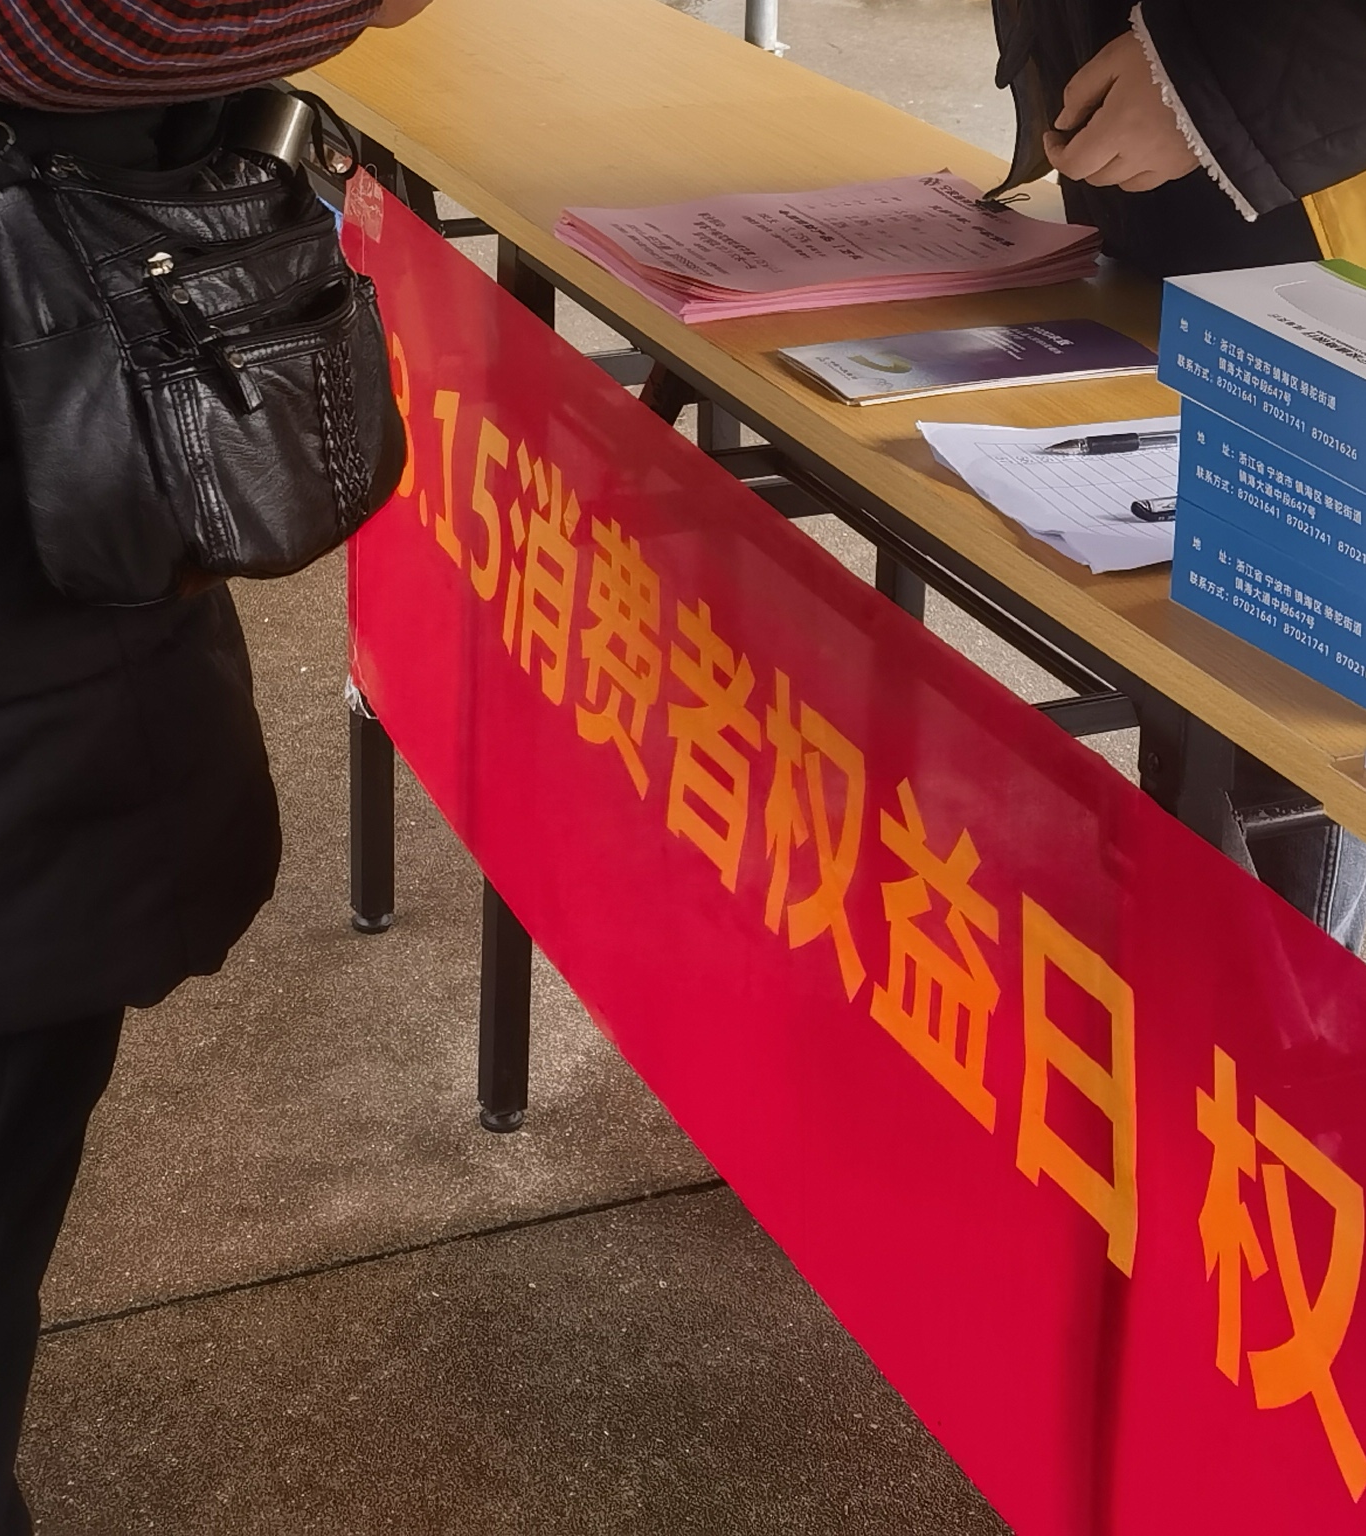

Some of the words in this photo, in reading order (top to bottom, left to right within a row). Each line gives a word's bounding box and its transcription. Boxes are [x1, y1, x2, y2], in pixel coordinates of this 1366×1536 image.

[1176, 352, 1214, 385] 联系方式：
[1216, 374, 1258, 407] 87021641
[1263, 400, 1306, 434] 87021741
[1311, 426, 1358, 461] 87021626
[1179, 316, 1189, 333] 地
[1219, 337, 1245, 362] 浙江省
[1246, 350, 1272, 375] 宁波市
[1273, 363, 1299, 390] 镇海区
[1300, 378, 1337, 411] 骆驼街道
[1218, 355, 1293, 407] 镇海大道中段647号
[1195, 465, 1235, 495] 联系方式：
[1237, 487, 1281, 519] 87021641
[1286, 513, 1332, 546] 87021741
[1196, 431, 1206, 446] 地
[1238, 451, 1265, 475] 浙江省
[1267, 465, 1293, 489] 宁波市
[1295, 478, 1323, 505] 镇海区
[1324, 492, 1364, 526] 骆驼街道
[1238, 469, 1316, 521] 镇海大道中段647号
[1189, 570, 1230, 603] 联系方式：
[1233, 595, 1278, 628] 87021641
[1283, 622, 1330, 657] 87021741
[1191, 536, 1202, 552] 地
[1235, 558, 1263, 583] 浙江省
[1264, 572, 1293, 598] 宁波市
[1294, 588, 1323, 616] 镇海区
[1324, 603, 1364, 638] 骆驼街道
[1234, 576, 1316, 630] 镇海大道中段647号
